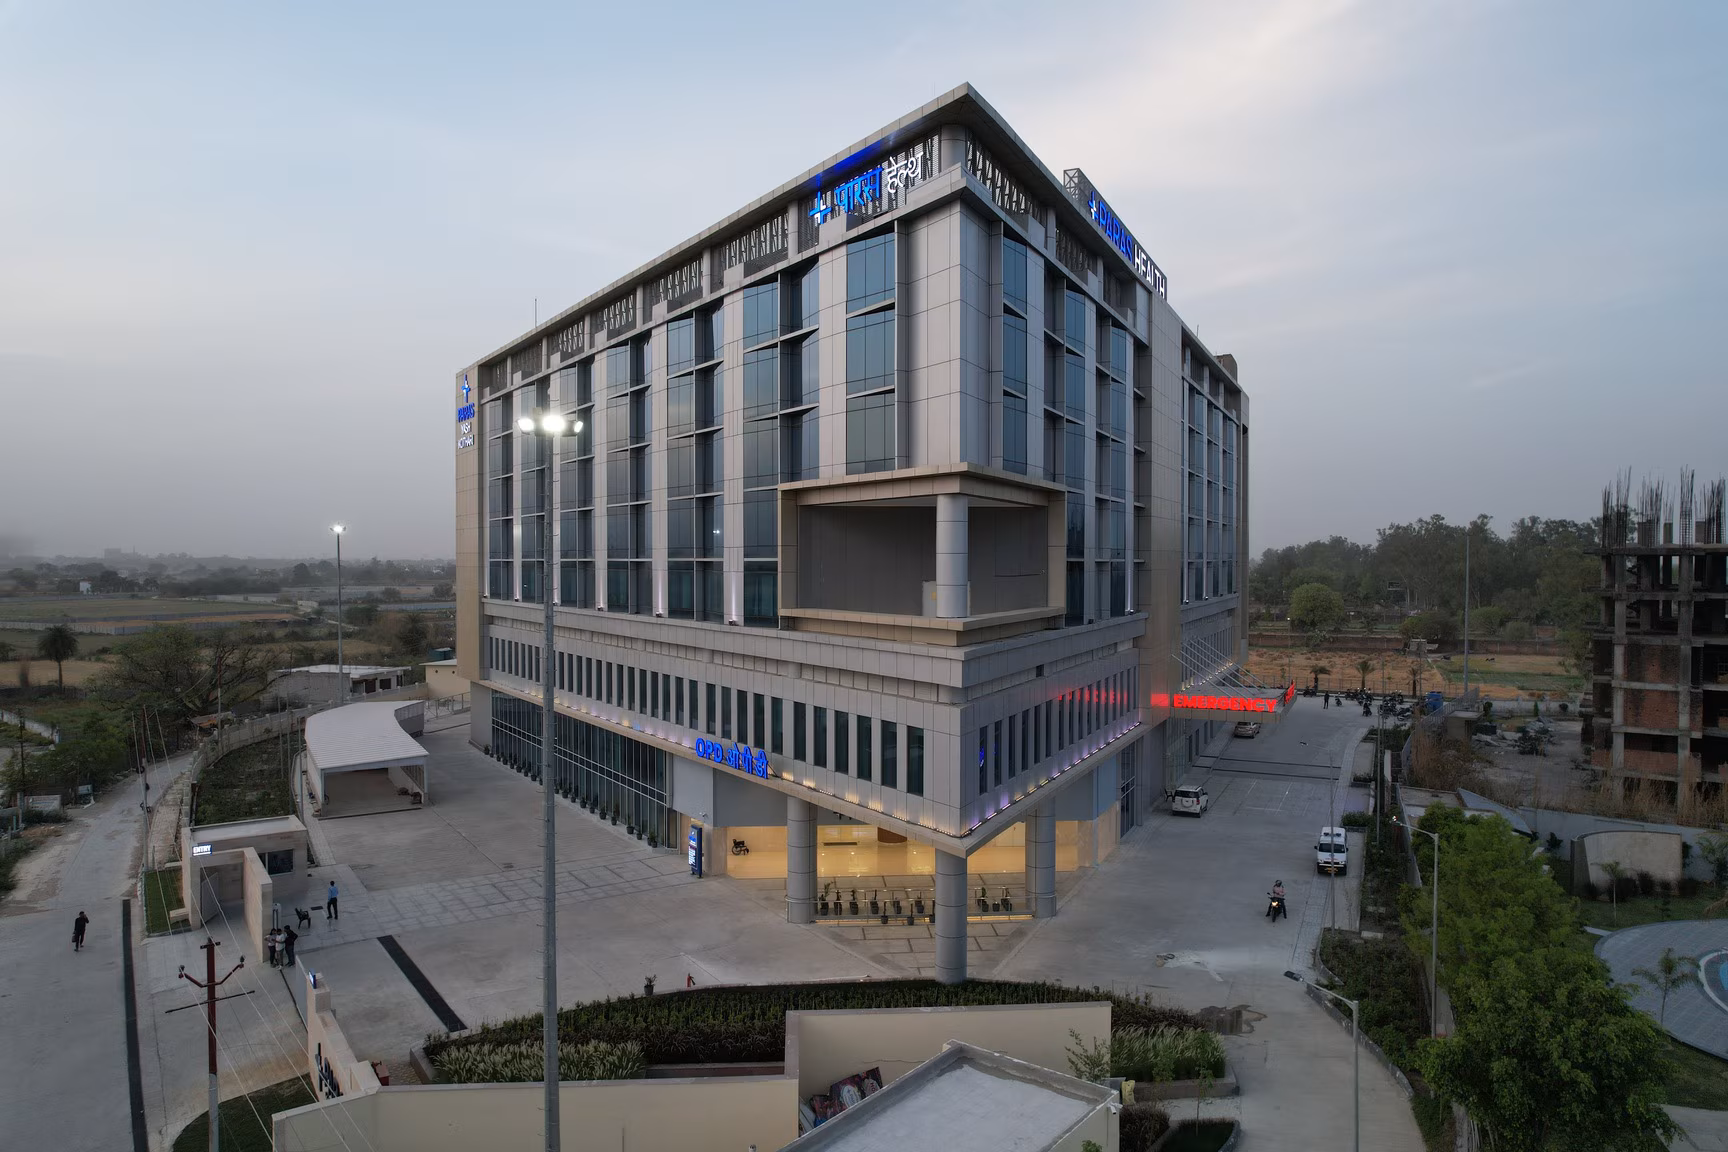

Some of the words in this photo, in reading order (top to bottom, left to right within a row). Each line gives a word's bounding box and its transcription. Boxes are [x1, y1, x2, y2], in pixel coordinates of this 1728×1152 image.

[834, 166, 884, 213] पारस
[1098, 200, 1133, 264] PARAS
[1173, 694, 1278, 712] EMERGENCY
[696, 738, 723, 763] OPD
[726, 742, 768, 779] ओपीडी
[193, 845, 211, 853] ENTRY
